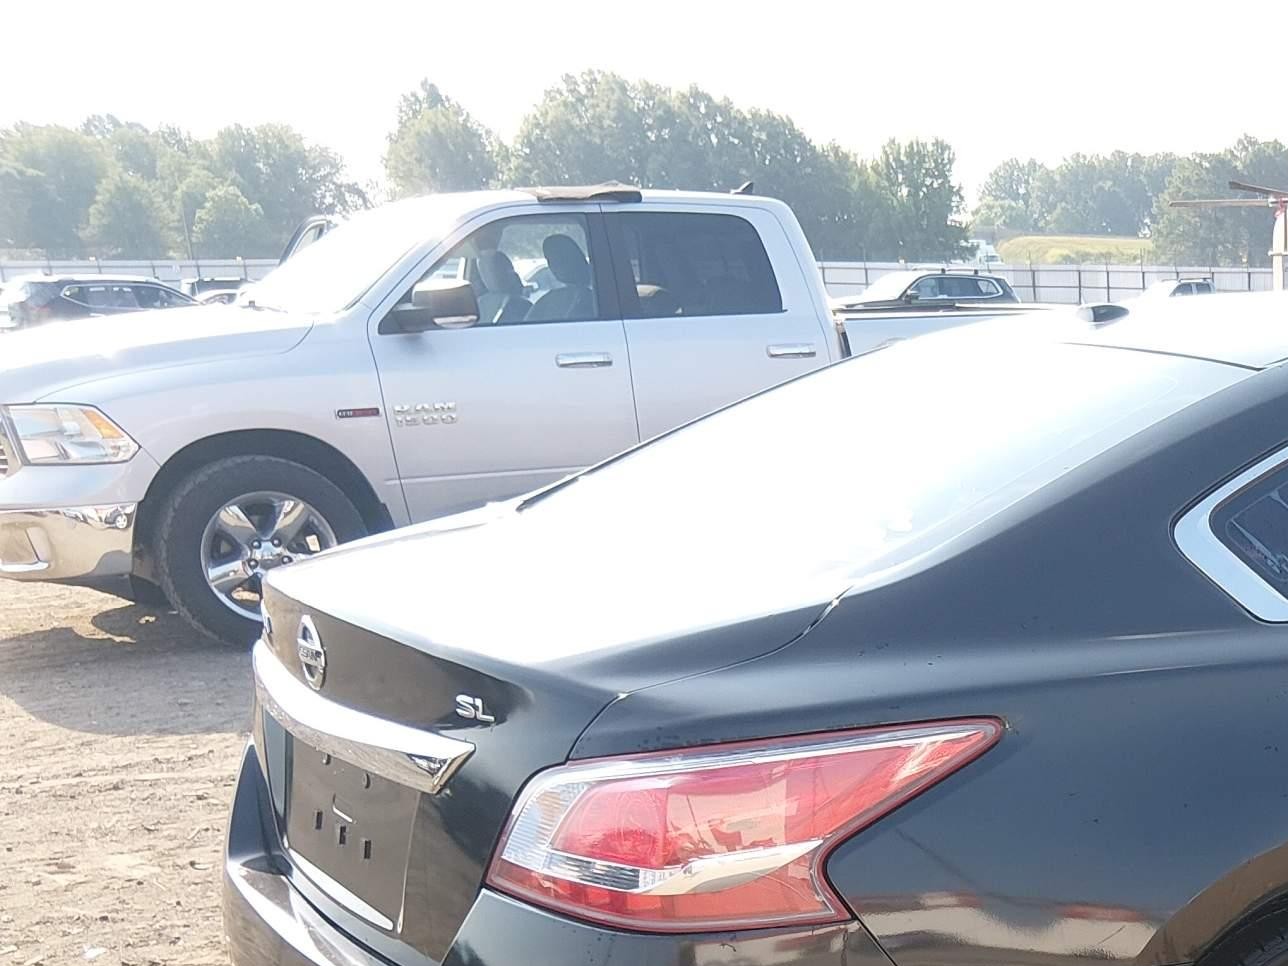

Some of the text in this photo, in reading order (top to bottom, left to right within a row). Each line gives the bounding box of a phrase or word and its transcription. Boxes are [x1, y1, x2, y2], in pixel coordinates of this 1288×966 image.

[393, 402, 457, 413] RAM
[395, 414, 458, 427] 1500
[455, 694, 495, 722] SL
